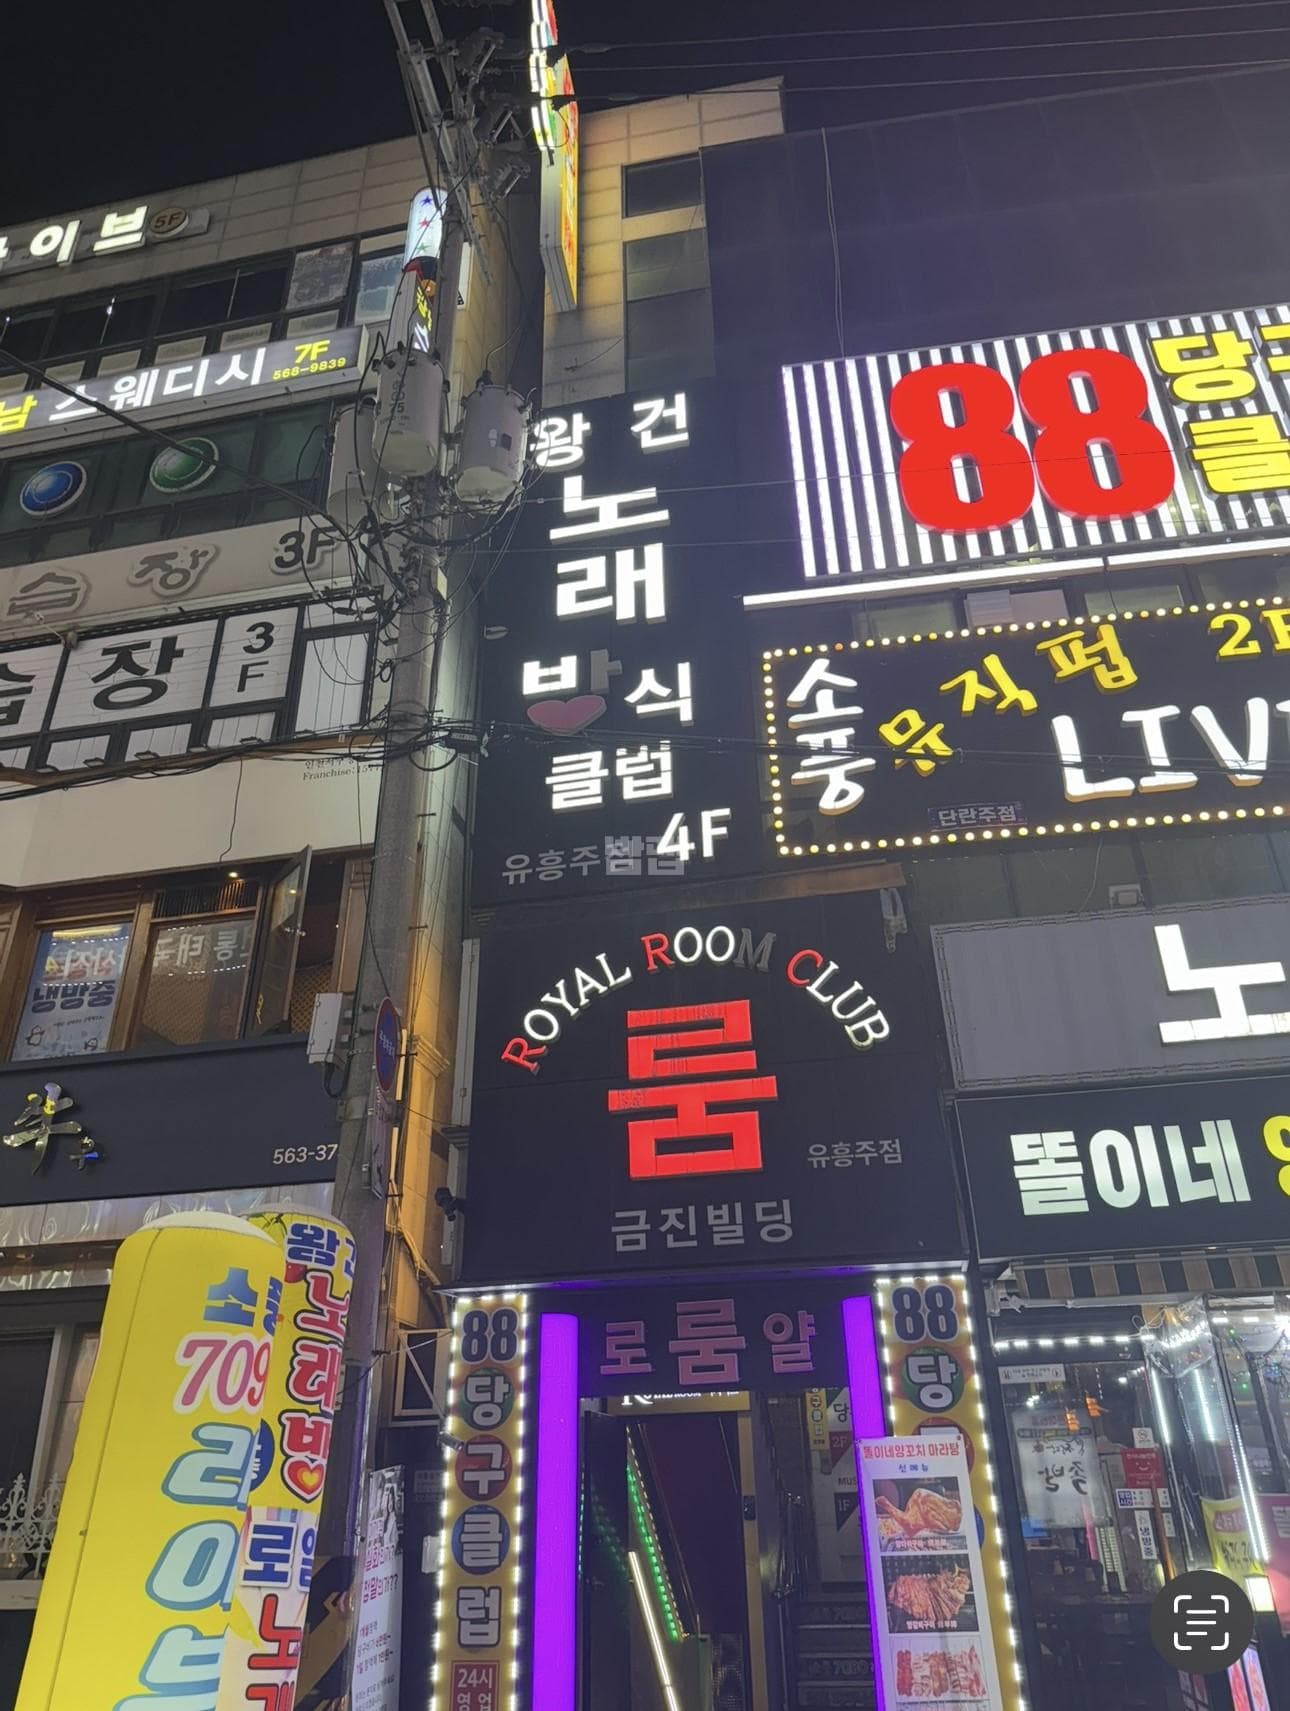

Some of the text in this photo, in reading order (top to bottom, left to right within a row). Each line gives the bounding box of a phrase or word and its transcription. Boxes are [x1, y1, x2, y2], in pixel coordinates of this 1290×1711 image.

[0, 205, 182, 267] 이브 5F
[272, 356, 347, 380] 568-9839
[295, 339, 331, 364] 7F
[48, 346, 267, 423] 스웨디시
[889, 347, 1175, 535] 88
[274, 525, 339, 569] 3F
[1050, 696, 1290, 796] LIV
[545, 739, 673, 811] 클럽
[656, 807, 731, 862] 4F
[938, 804, 1017, 827] 단란주점
[501, 925, 891, 1073] ROYAL ROOM CLUB
[1154, 924, 1290, 1044] 노
[608, 999, 778, 1180] 룸
[272, 1143, 339, 1165] 563-37
[807, 1138, 903, 1169] 유흥주점
[1009, 1119, 1252, 1216] 똘이네
[610, 1199, 794, 1252] 금진빌딩
[460, 1309, 520, 1364] 88
[892, 1285, 958, 1344] 88
[457, 1667, 493, 1690] 24시
